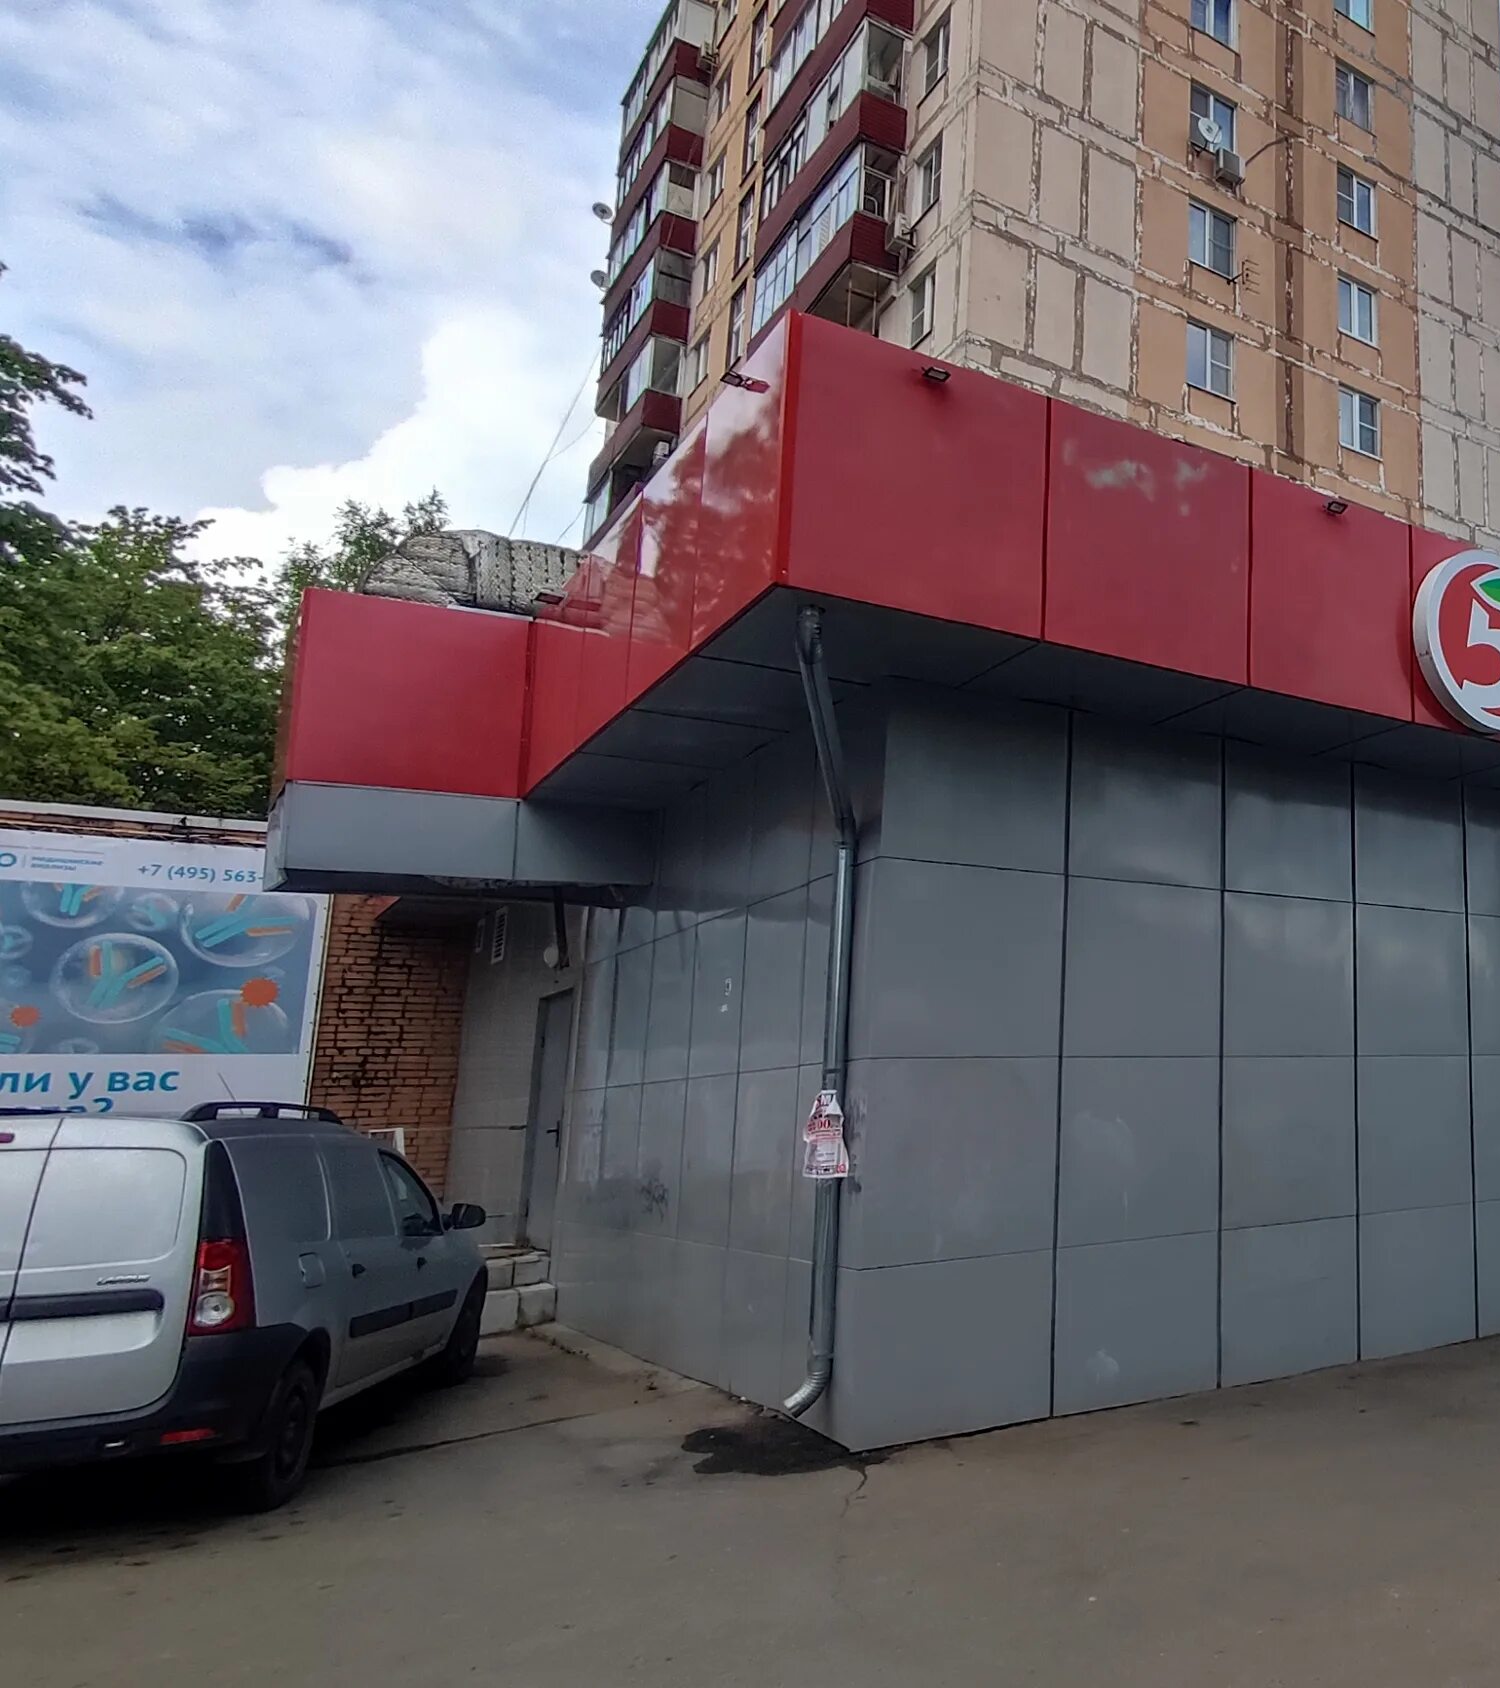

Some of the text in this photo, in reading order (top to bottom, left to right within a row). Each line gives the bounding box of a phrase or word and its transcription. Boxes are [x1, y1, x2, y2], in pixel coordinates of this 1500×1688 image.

[138, 863, 163, 877] +7
[167, 864, 216, 883] (495)
[68, 1071, 94, 1100] у
[107, 1070, 180, 1093] вас
